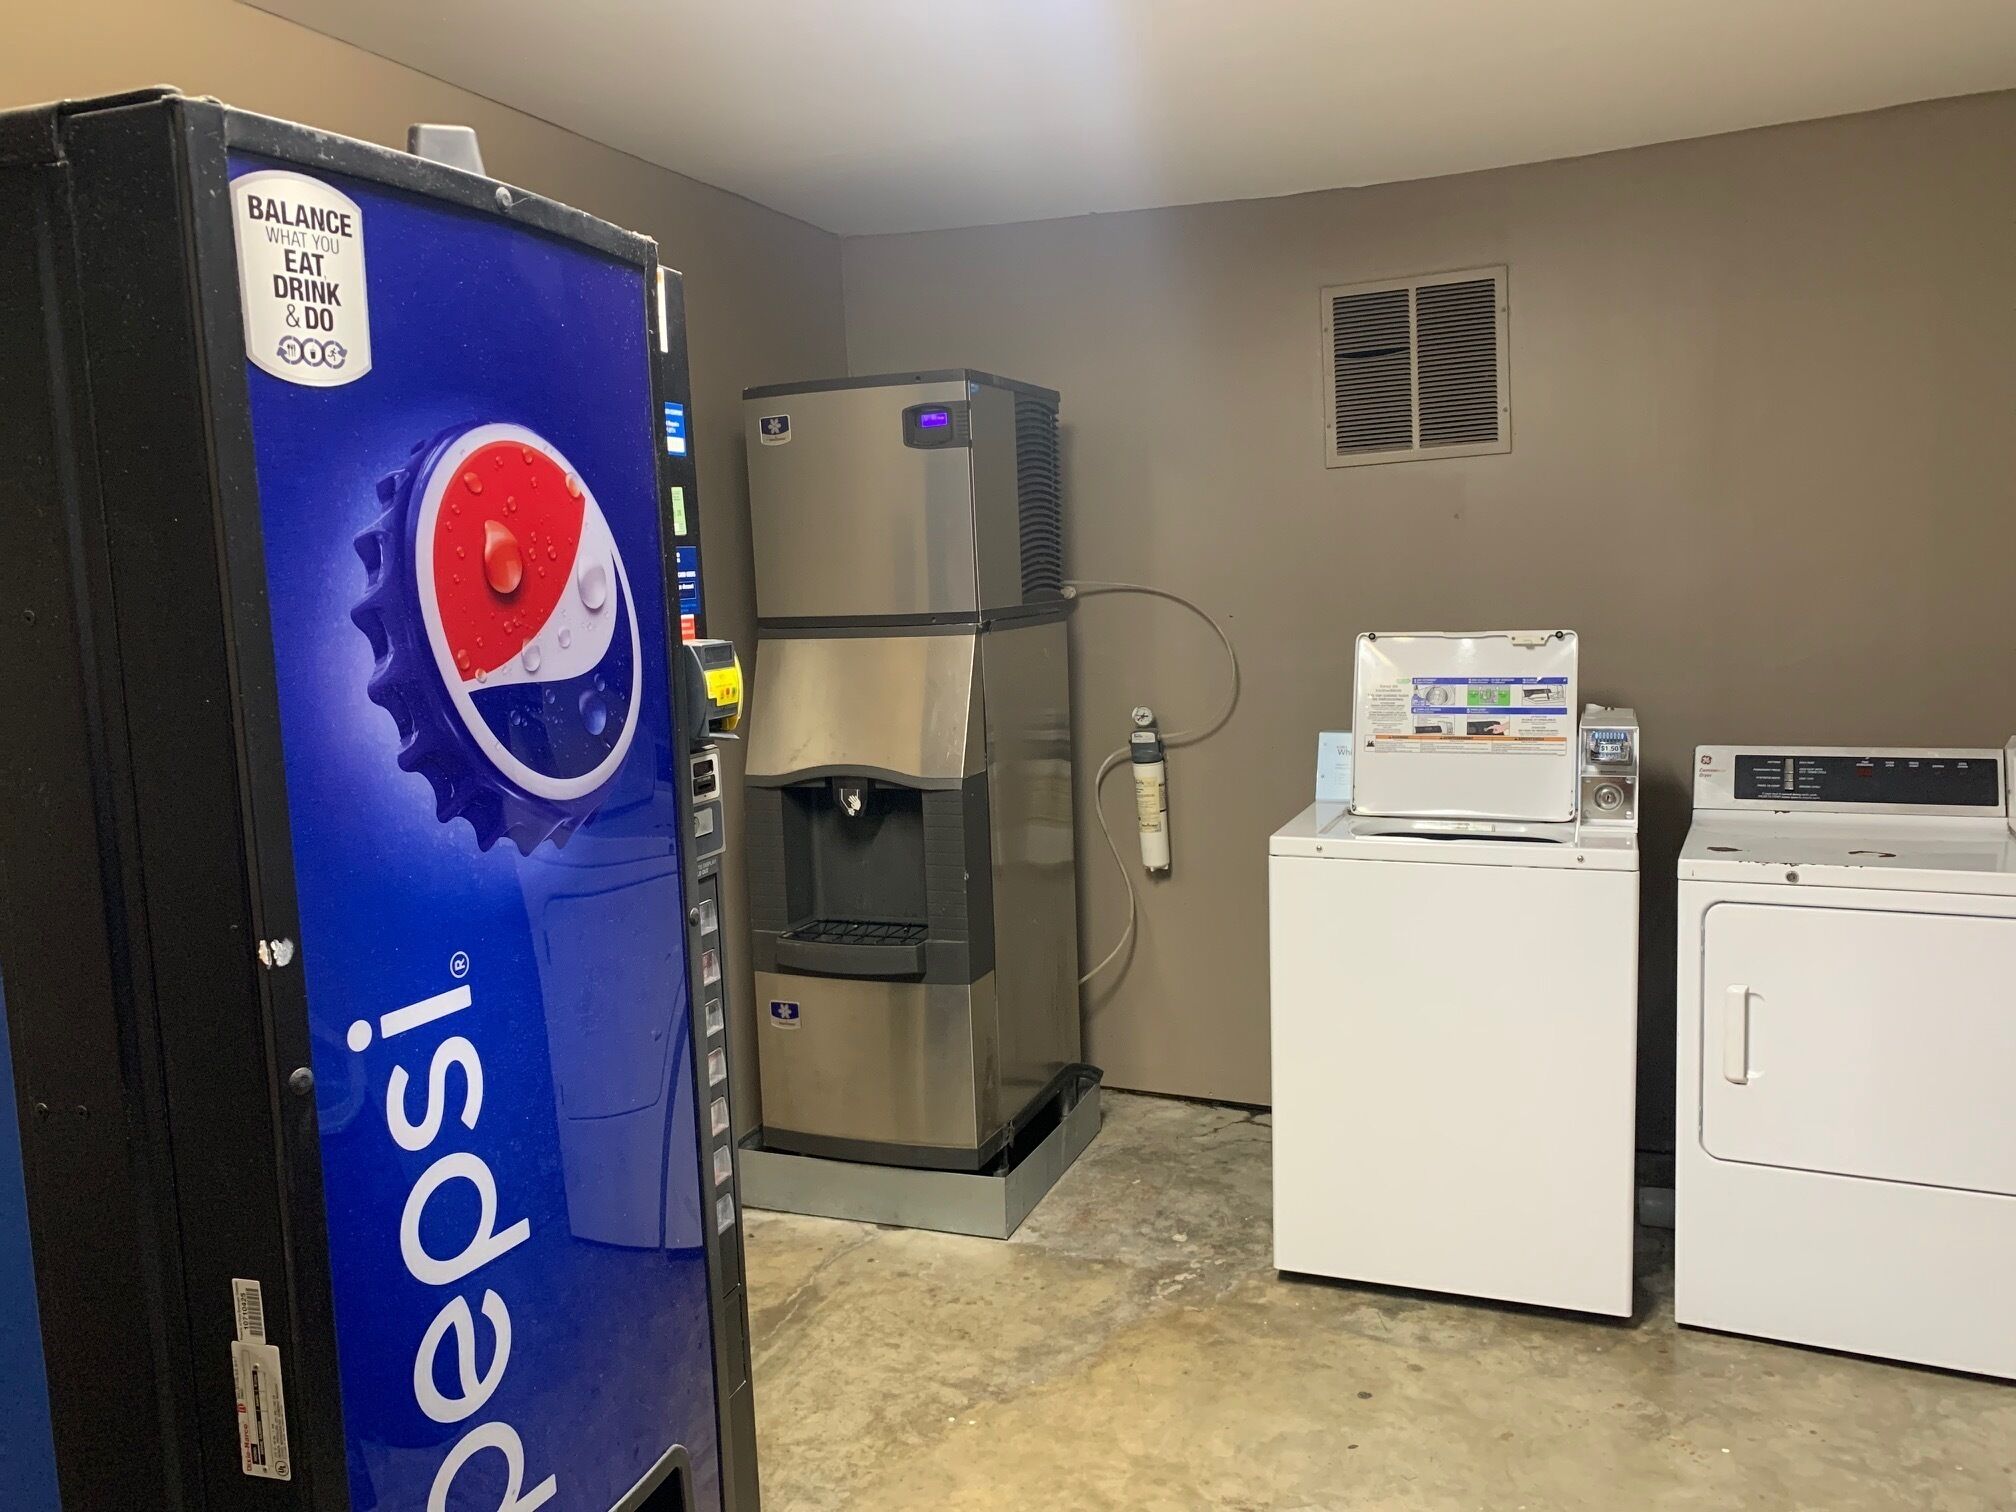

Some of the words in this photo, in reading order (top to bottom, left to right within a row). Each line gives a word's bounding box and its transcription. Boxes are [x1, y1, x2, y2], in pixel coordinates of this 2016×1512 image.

[247, 194, 353, 238] BALANCE
[265, 225, 307, 249] WHAT
[312, 234, 340, 255] YOU
[273, 274, 342, 307] DRINK
[286, 303, 301, 329] &
[304, 306, 334, 332] DO
[347, 984, 556, 1512] pepsi
